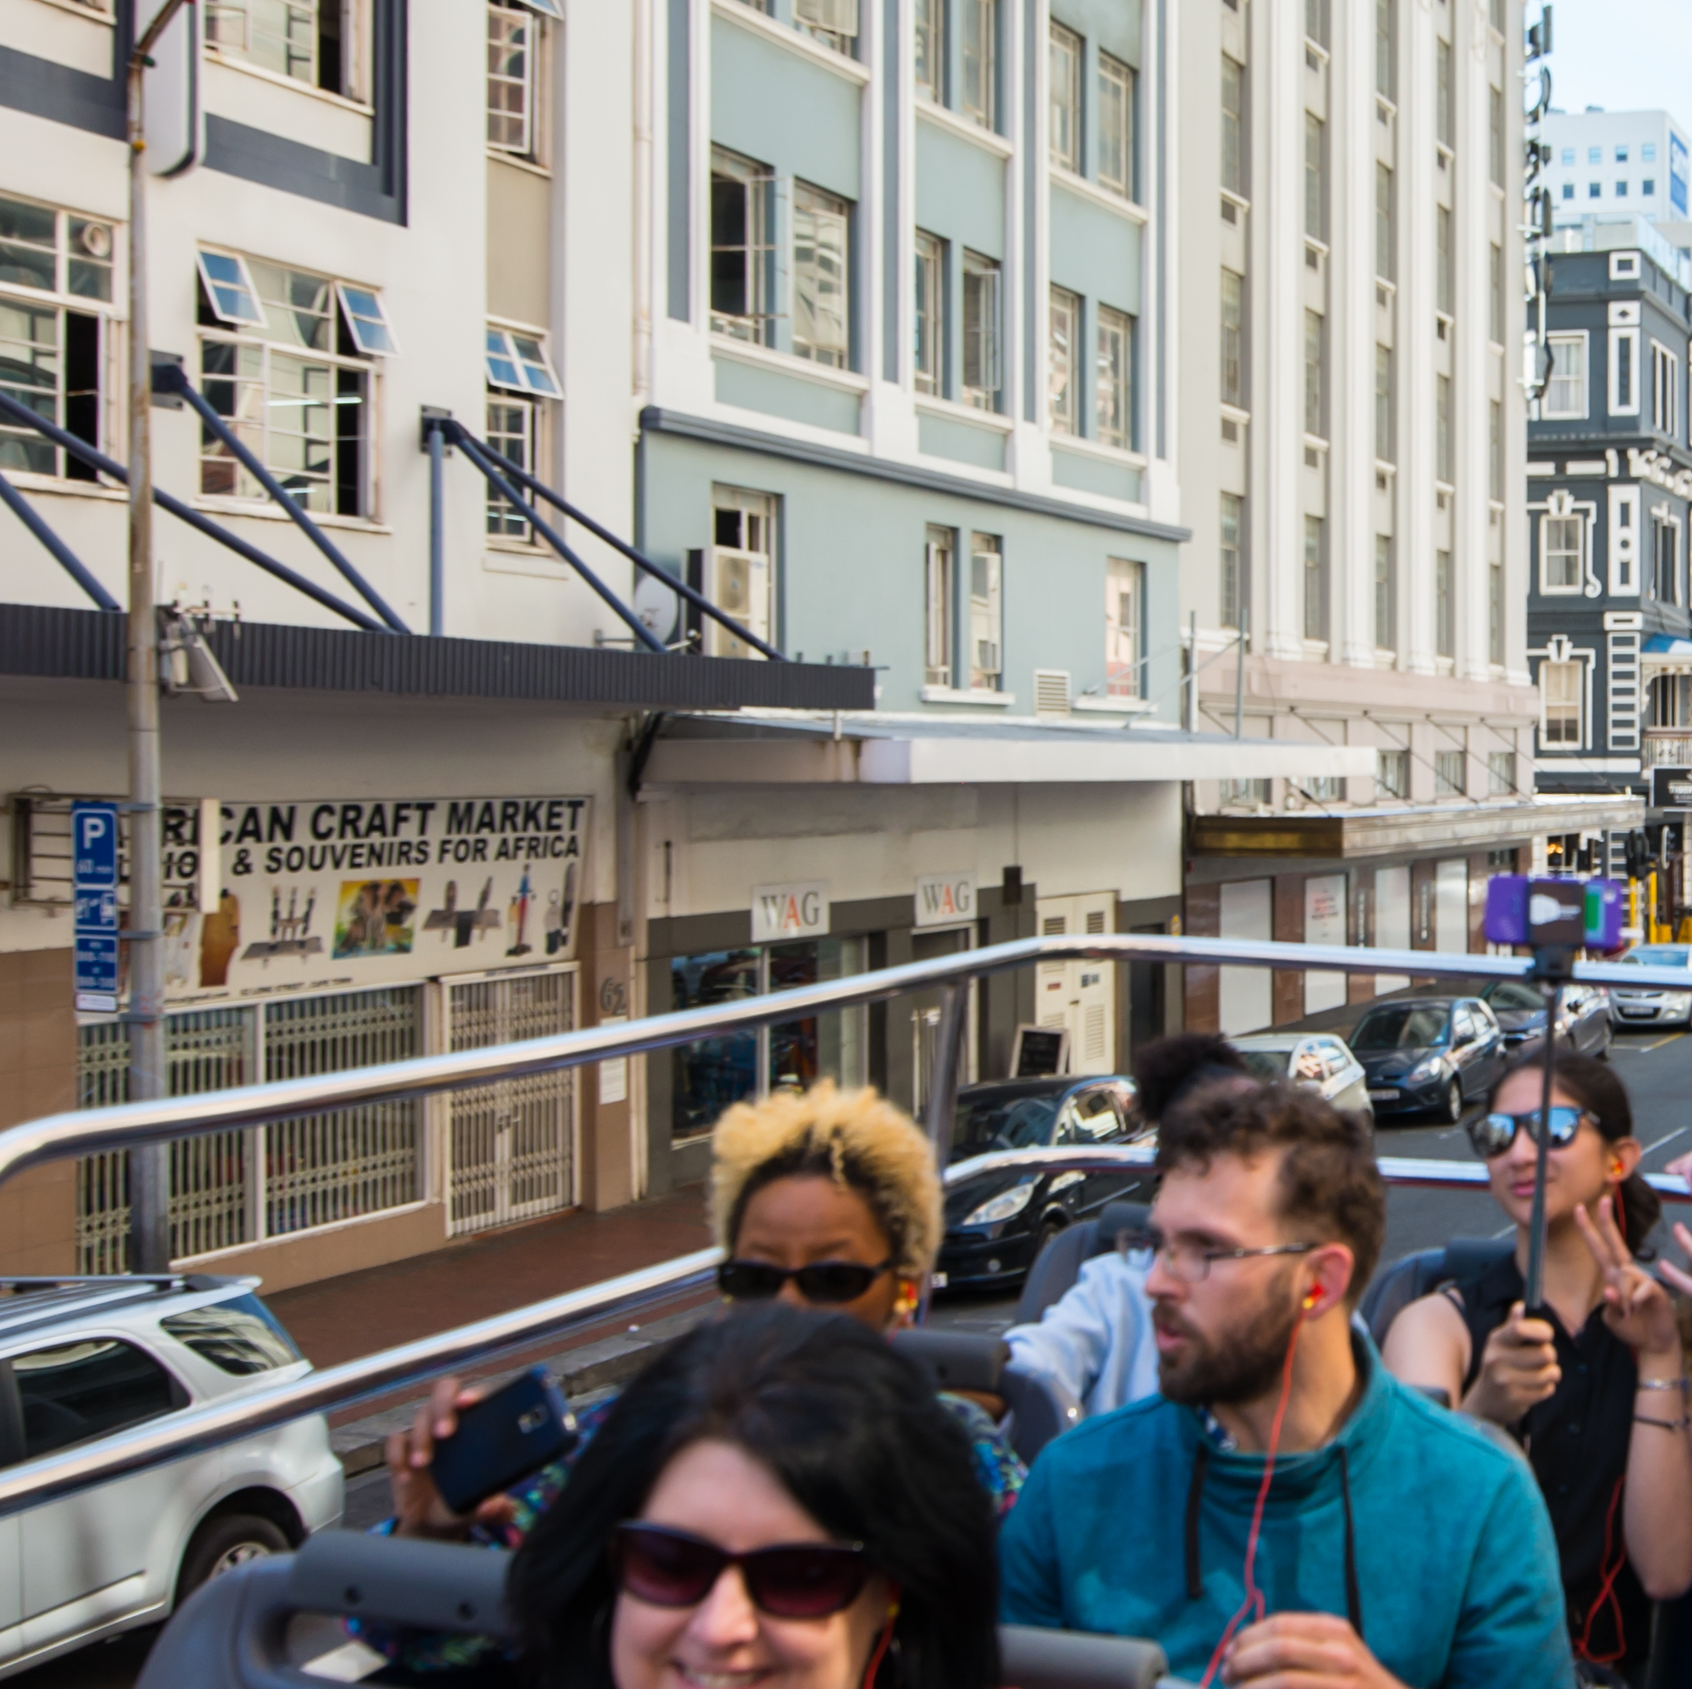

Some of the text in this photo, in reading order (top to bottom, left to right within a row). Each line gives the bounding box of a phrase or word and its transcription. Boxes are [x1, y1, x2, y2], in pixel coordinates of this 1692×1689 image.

[83, 817, 106, 850] P
[310, 802, 437, 841] CRAFT
[446, 800, 585, 836] MARKET
[231, 847, 254, 877] &
[264, 840, 430, 874] SOUVENIRS
[437, 838, 489, 865] FOR
[494, 835, 580, 861] AFRICA
[761, 890, 820, 930] WAG
[922, 880, 970, 915] WAG
